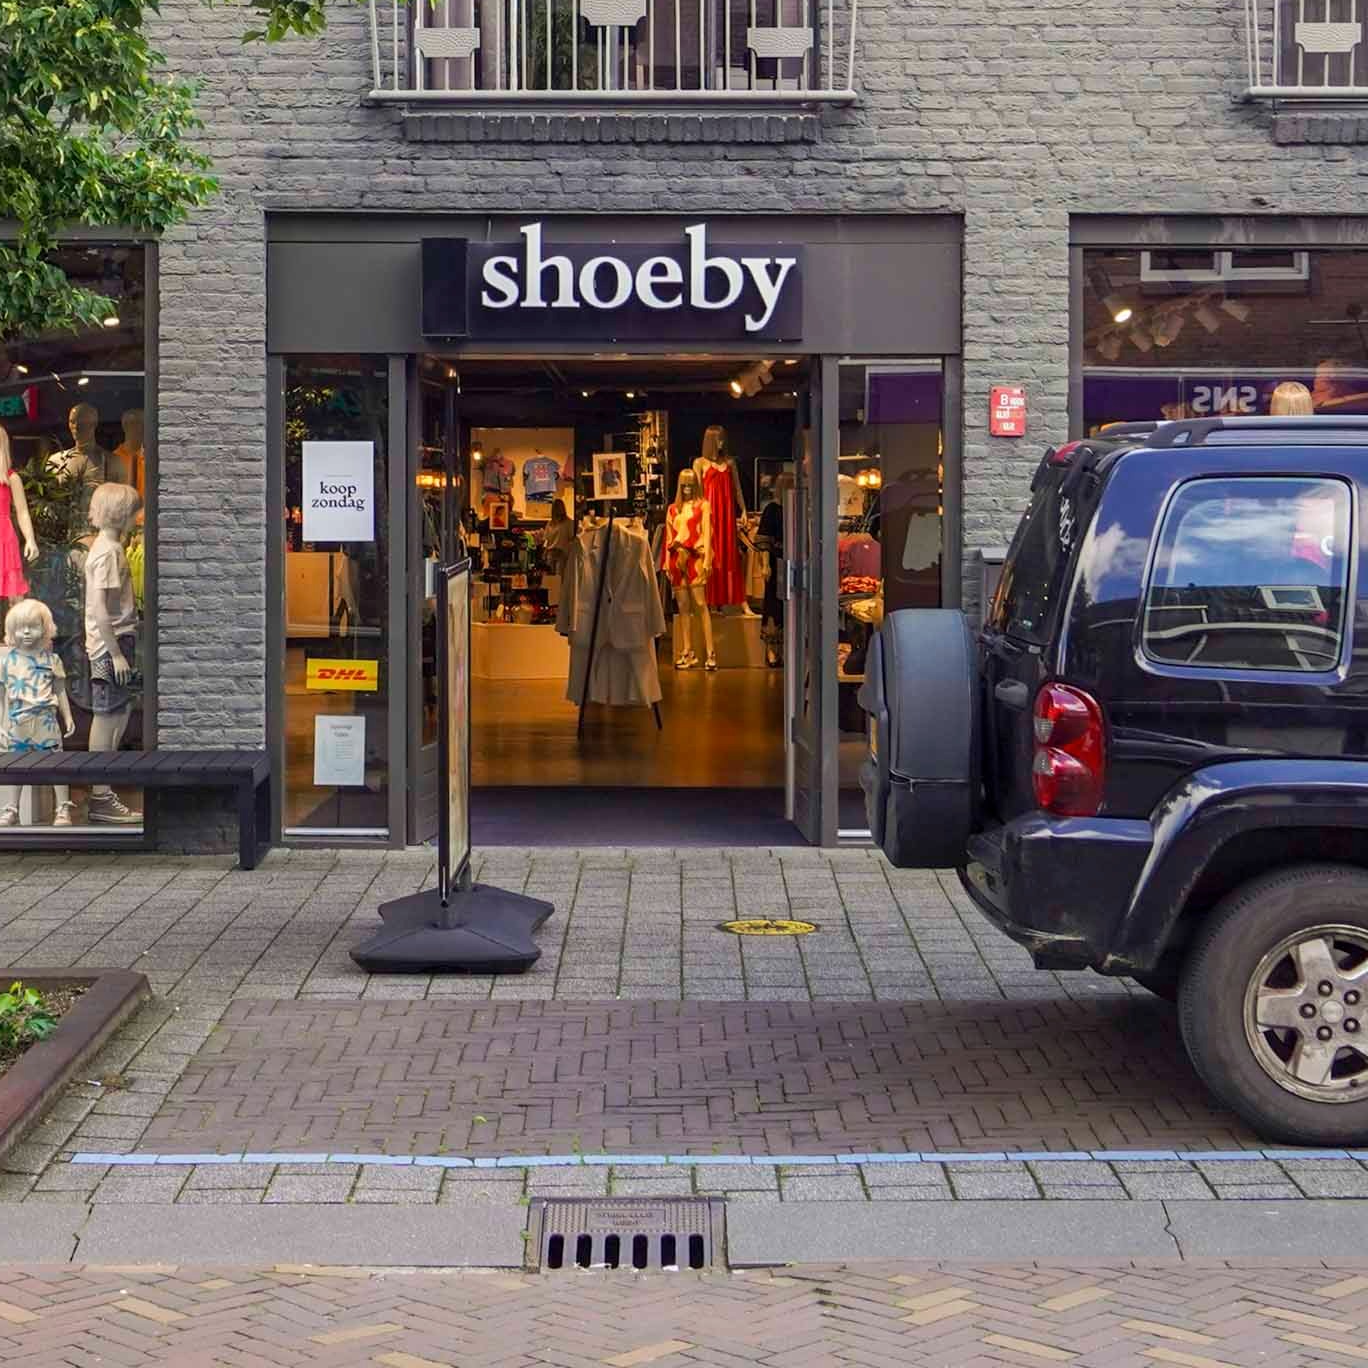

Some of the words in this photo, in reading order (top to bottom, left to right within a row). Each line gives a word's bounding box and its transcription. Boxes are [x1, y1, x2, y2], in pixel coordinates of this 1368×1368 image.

[482, 222, 797, 332] shoeby
[320, 481, 357, 498] koop
[312, 495, 366, 512] zondag
[317, 668, 368, 681] DHL
